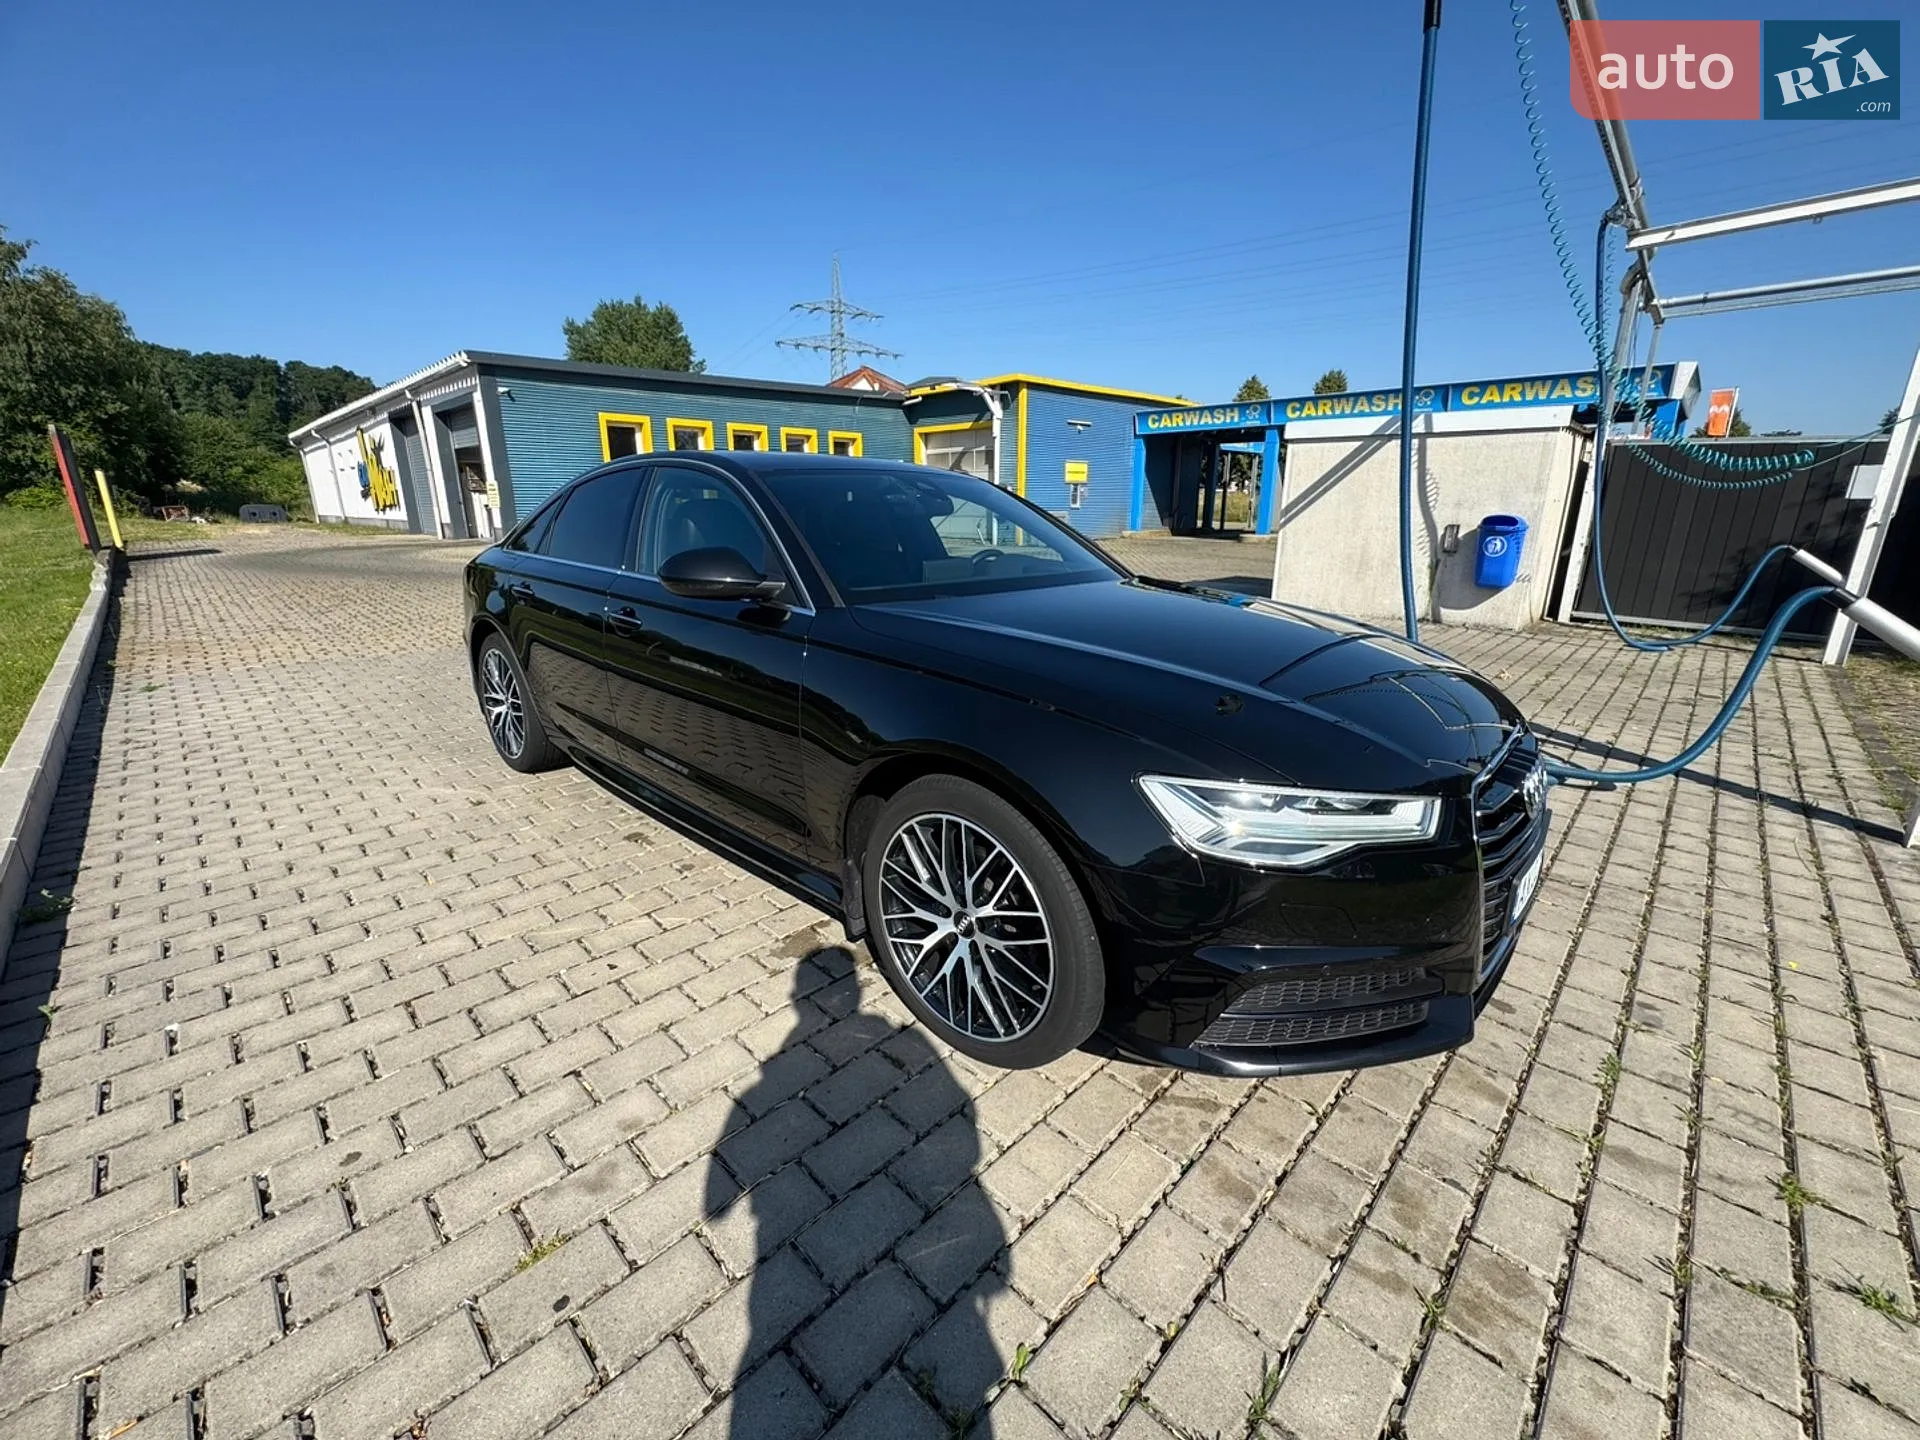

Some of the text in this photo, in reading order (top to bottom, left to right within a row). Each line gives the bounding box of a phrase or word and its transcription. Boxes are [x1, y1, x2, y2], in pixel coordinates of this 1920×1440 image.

[1461, 375, 1599, 406] CARWAS
[1148, 407, 1239, 429] CARWASH
[1286, 393, 1402, 419] CARWASH
